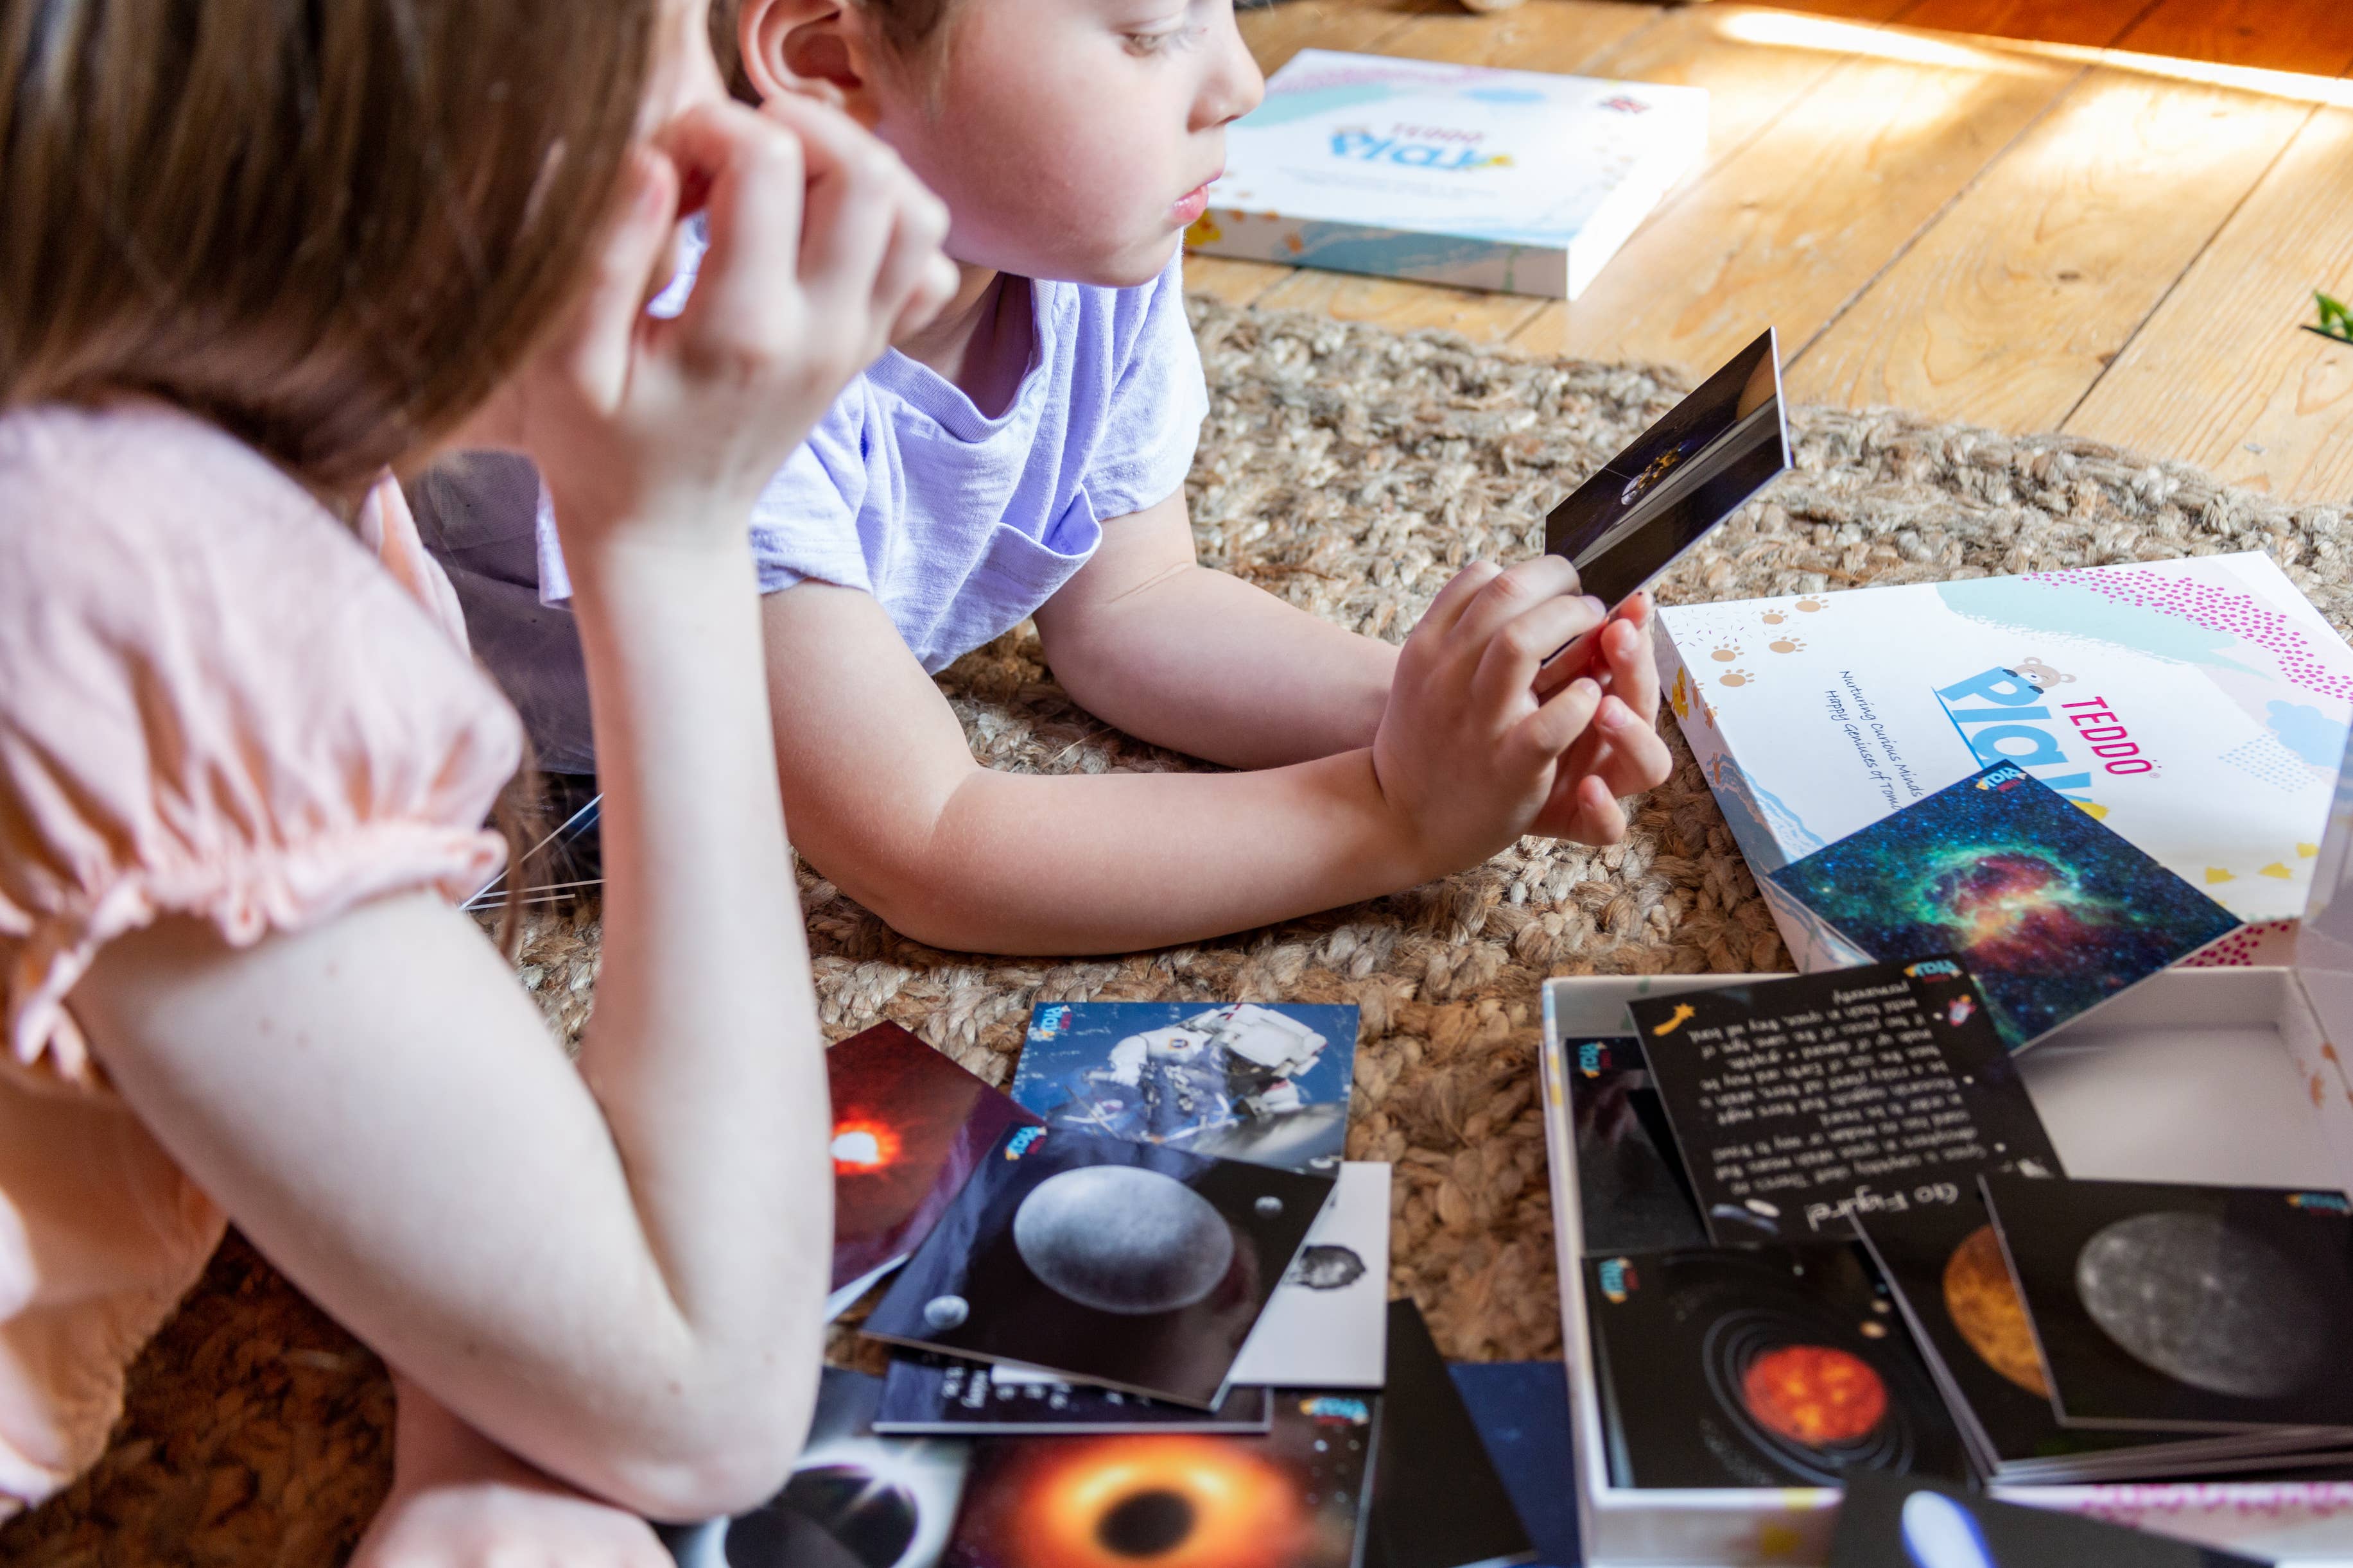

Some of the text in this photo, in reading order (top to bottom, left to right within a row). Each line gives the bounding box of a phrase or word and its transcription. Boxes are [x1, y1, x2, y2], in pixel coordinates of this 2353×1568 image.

[1825, 691, 1850, 721] Happy
[1844, 723, 1879, 768] Geniuses
[1869, 770, 1892, 780] of
[1839, 671, 1925, 797] Nurturing Curious Minds
[1914, 1182, 1959, 1205] Go
